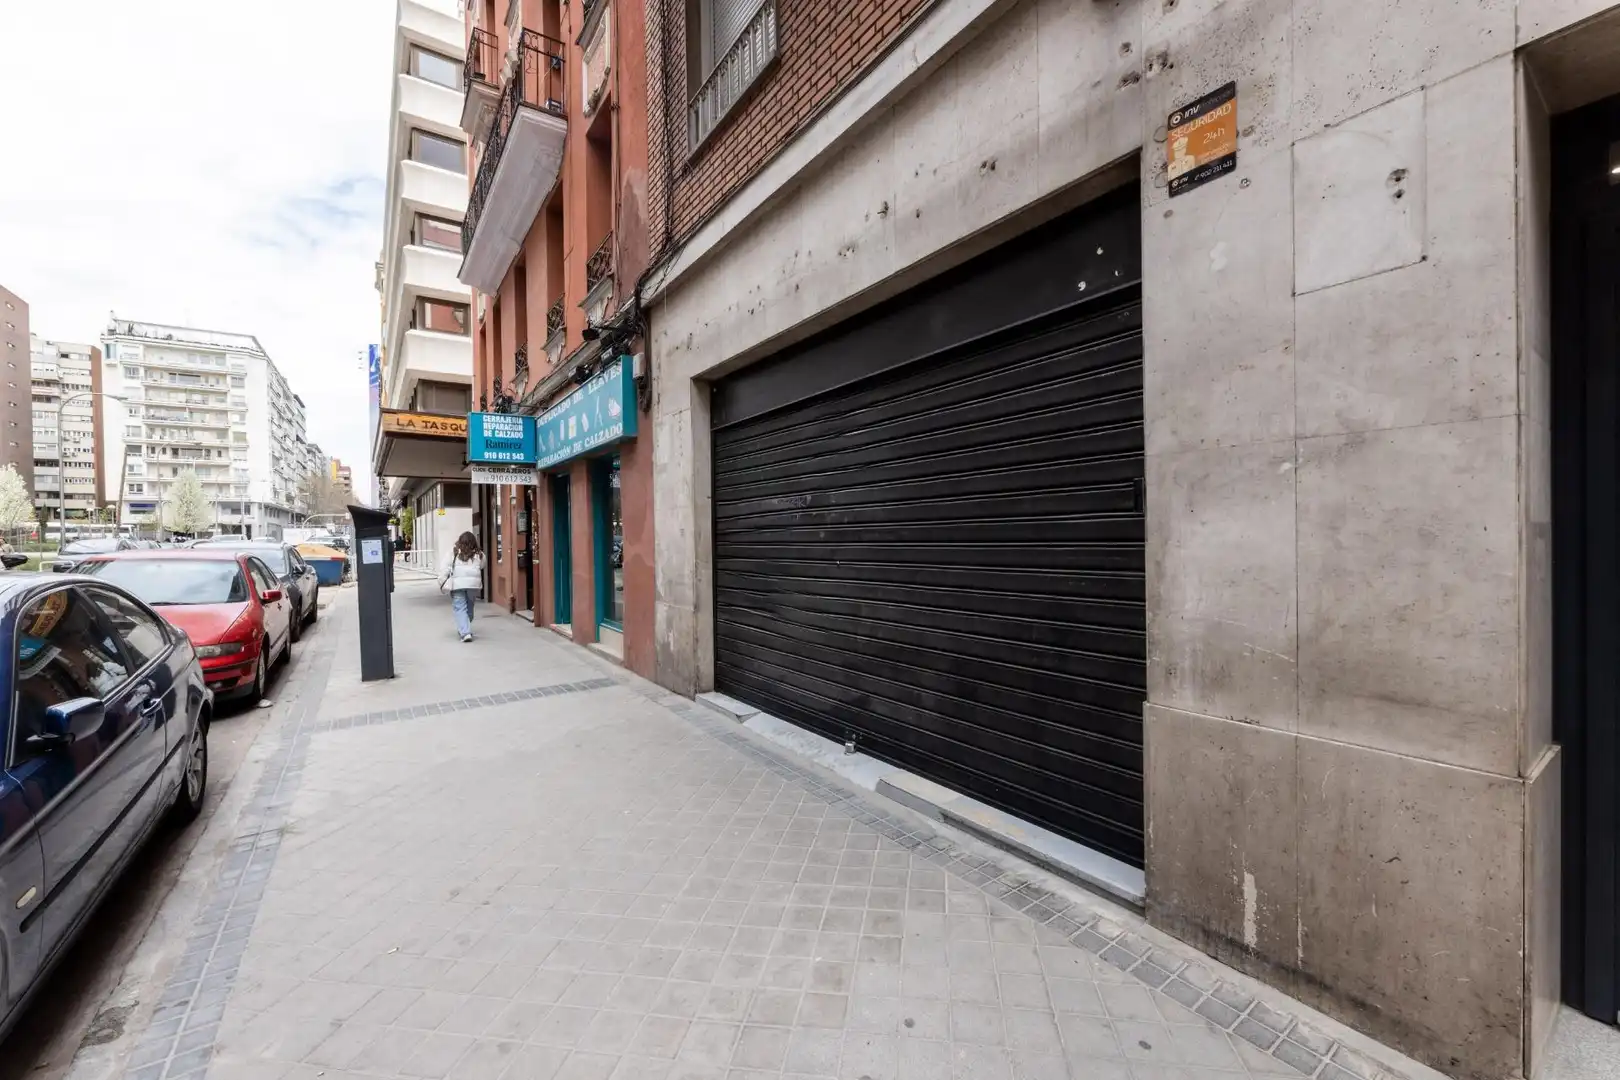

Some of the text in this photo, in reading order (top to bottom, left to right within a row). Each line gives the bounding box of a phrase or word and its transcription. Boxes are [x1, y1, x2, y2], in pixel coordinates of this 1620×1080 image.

[1172, 102, 1232, 140] SEGURIDAD
[1203, 127, 1225, 144] 24h
[573, 388, 584, 405] DE
[588, 361, 622, 395] LLAVES
[396, 417, 416, 428] LA
[494, 430, 524, 439] CALZADO
[573, 440, 583, 452] DE
[584, 422, 623, 447] CALZADO
[484, 451, 497, 459] 910
[498, 452, 510, 460] 612
[487, 467, 532, 475] CERRAJEROS
[490, 474, 504, 482] 910
[504, 475, 518, 483] 612
[519, 475, 532, 483] 543
